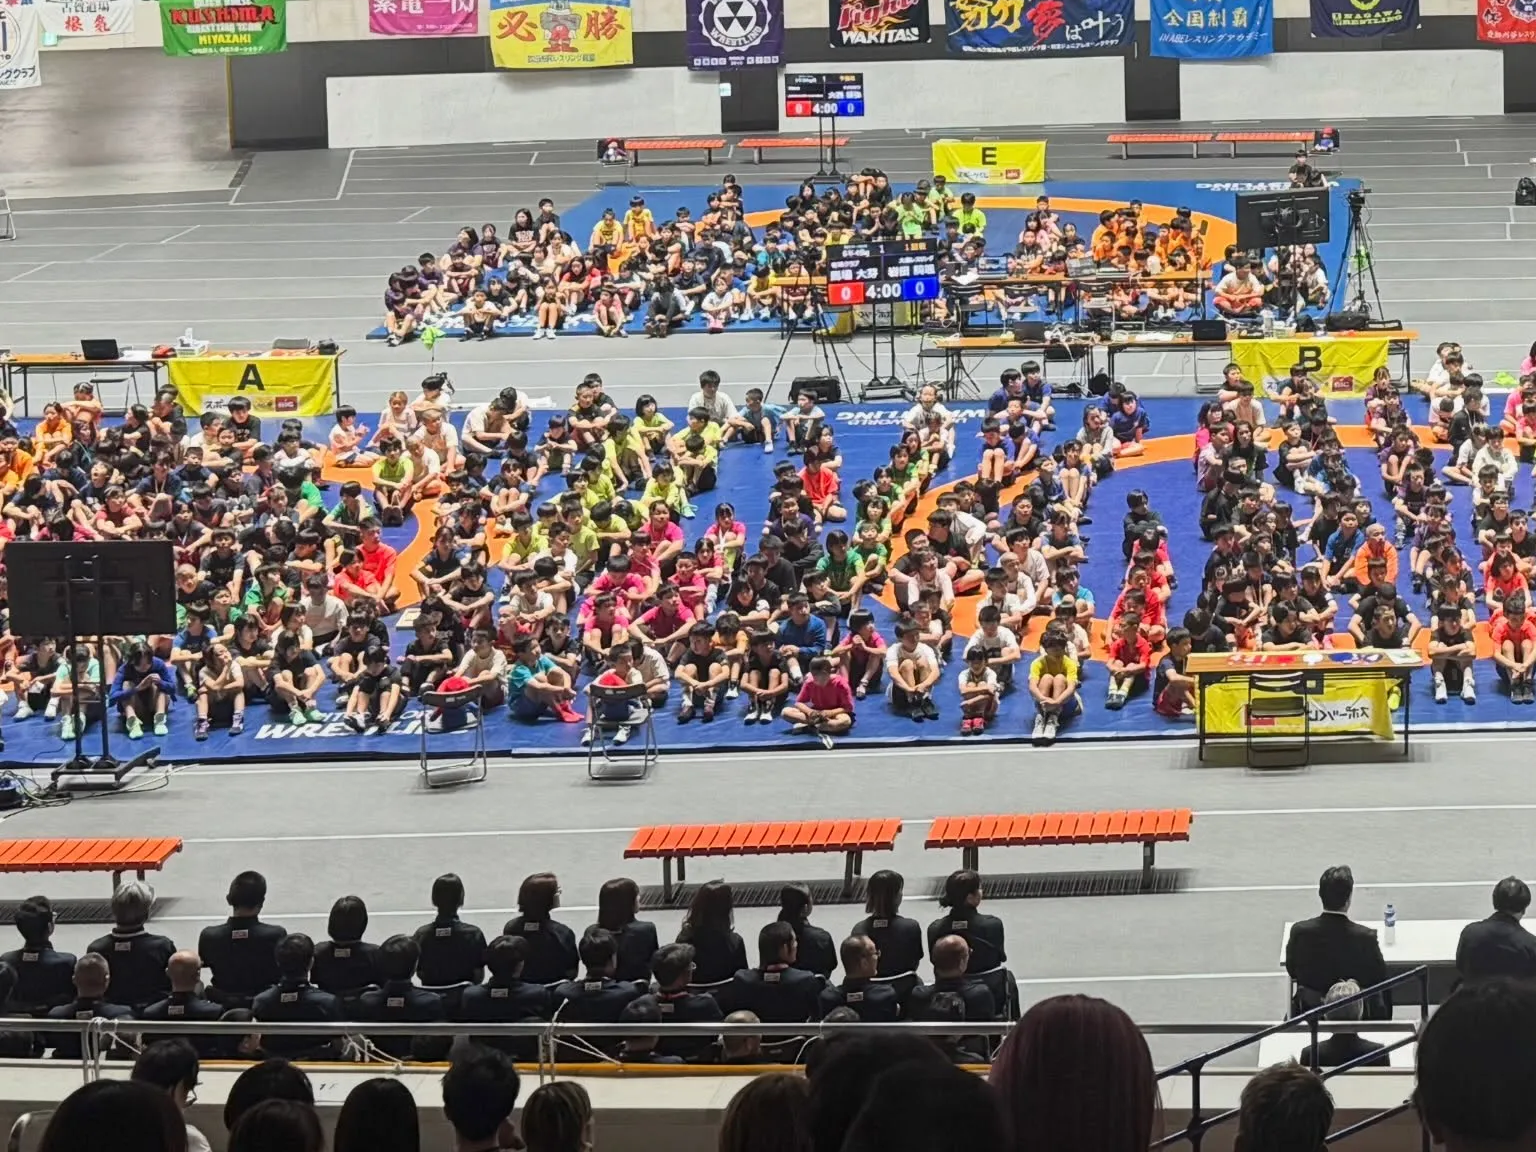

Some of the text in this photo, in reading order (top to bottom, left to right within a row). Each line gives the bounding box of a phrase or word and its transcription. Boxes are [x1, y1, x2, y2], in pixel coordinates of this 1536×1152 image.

[496, 5, 625, 42] 必 勝
[199, 33, 252, 44] MIYAZAKI
[812, 102, 838, 114] 4:00
[847, 102, 854, 114] 0
[981, 147, 997, 166] E
[841, 281, 925, 300] 0 4:00 0
[1299, 346, 1322, 372] B
[237, 364, 265, 390] A
